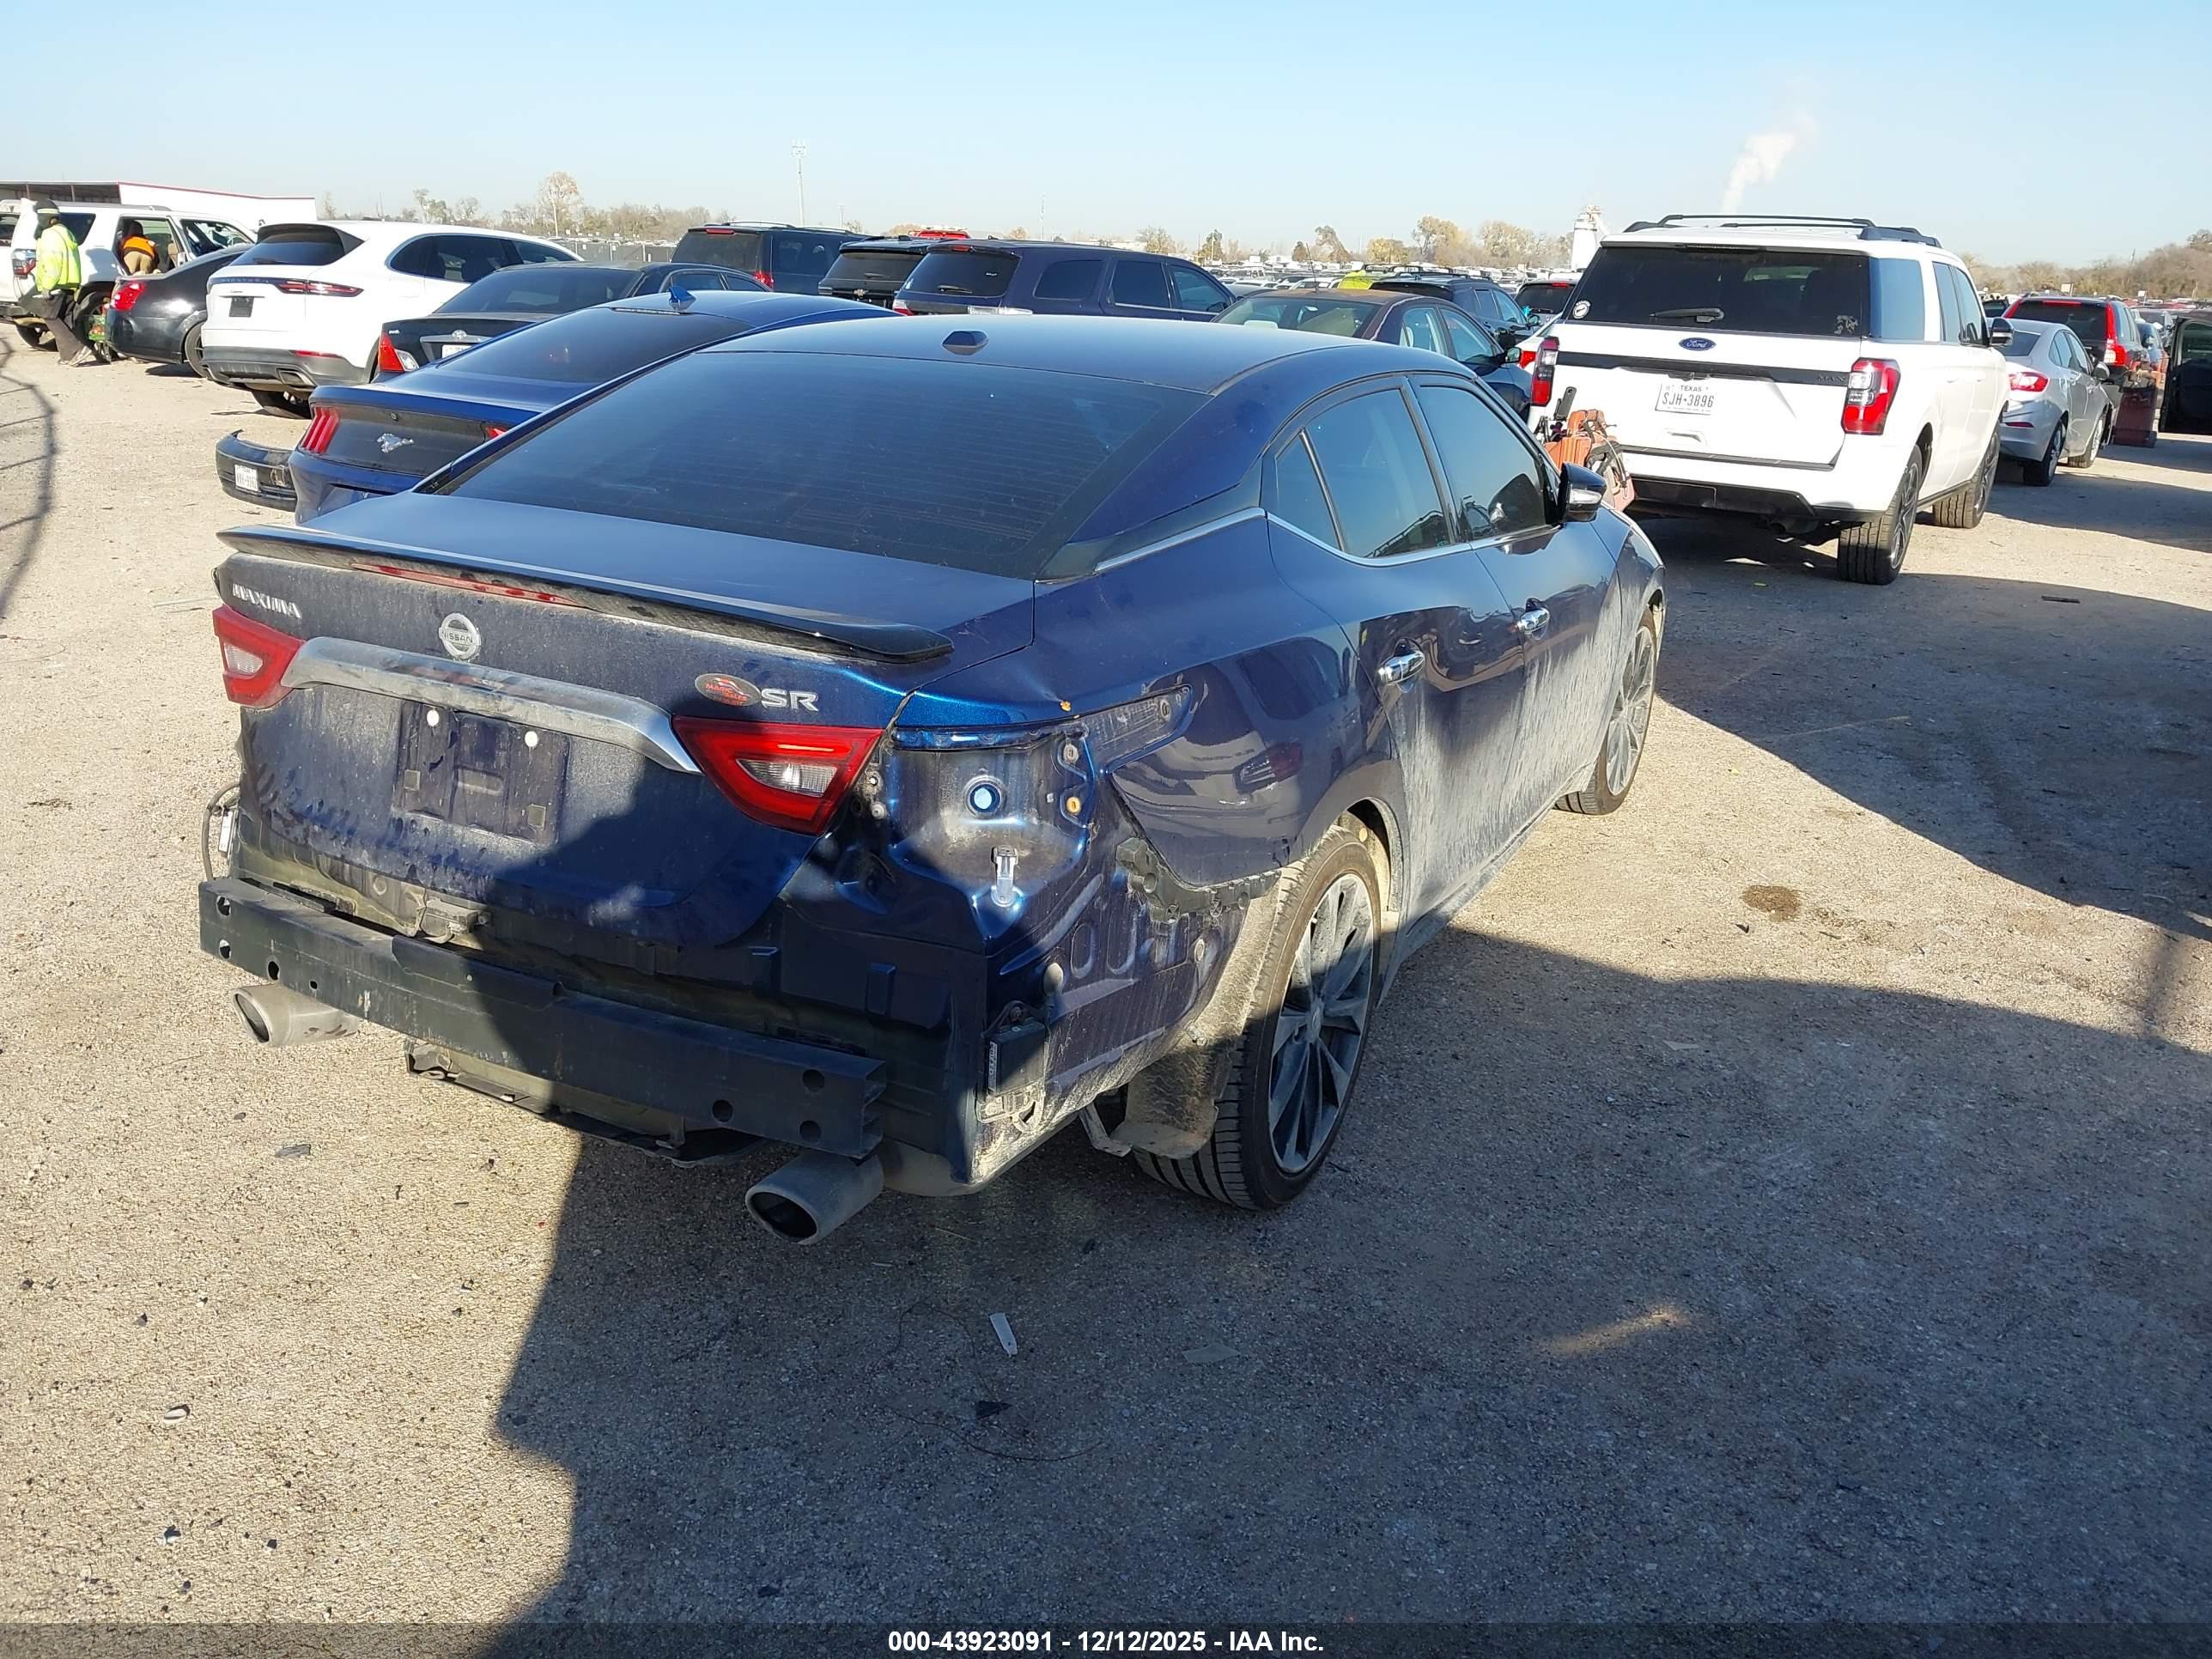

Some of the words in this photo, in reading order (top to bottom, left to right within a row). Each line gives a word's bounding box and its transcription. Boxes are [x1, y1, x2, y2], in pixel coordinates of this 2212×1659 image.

[233, 583, 301, 618] MAXIMA
[441, 629, 473, 643] NISSAN
[761, 688, 819, 712] SR
